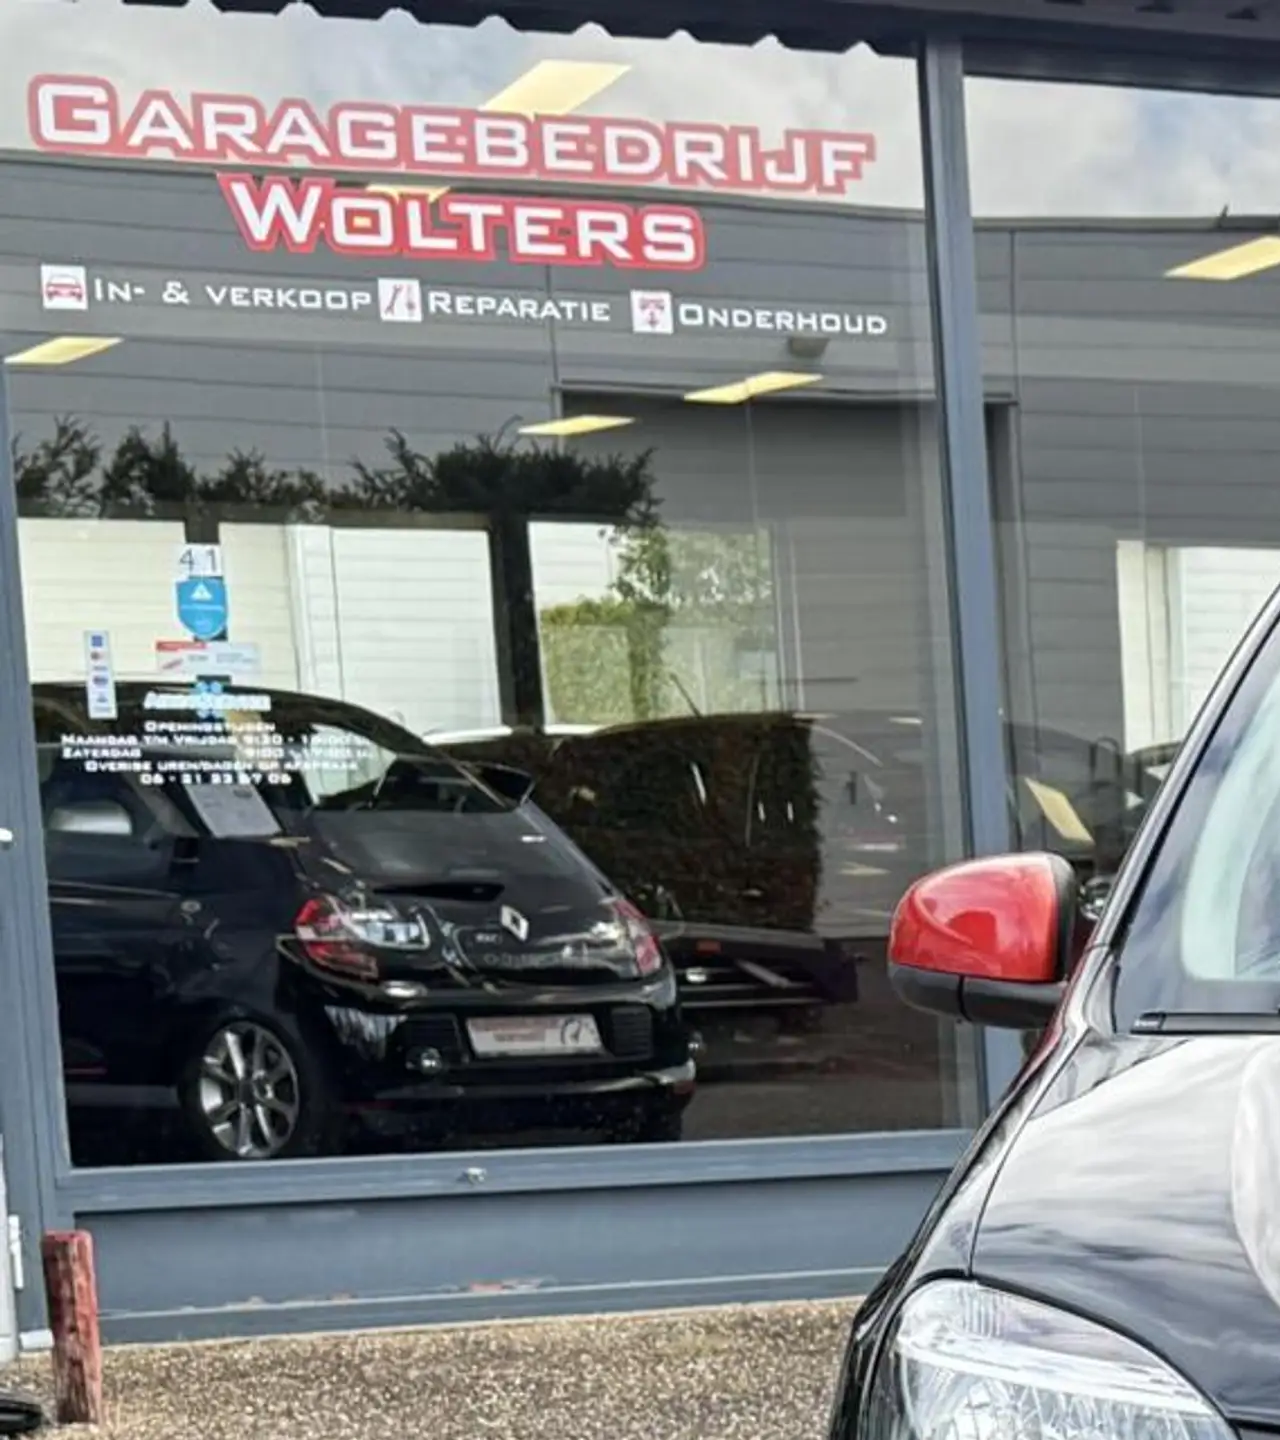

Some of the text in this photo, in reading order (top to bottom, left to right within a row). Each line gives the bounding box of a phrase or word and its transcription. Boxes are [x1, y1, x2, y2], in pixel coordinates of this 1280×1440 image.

[30, 74, 874, 195] GARAGEBEDRIJF
[218, 172, 706, 269] WOLTERS
[161, 281, 190, 305] &
[204, 283, 373, 310] VERKOOP
[427, 291, 612, 322] REPARATIE
[678, 302, 888, 335] ONDERHOUD
